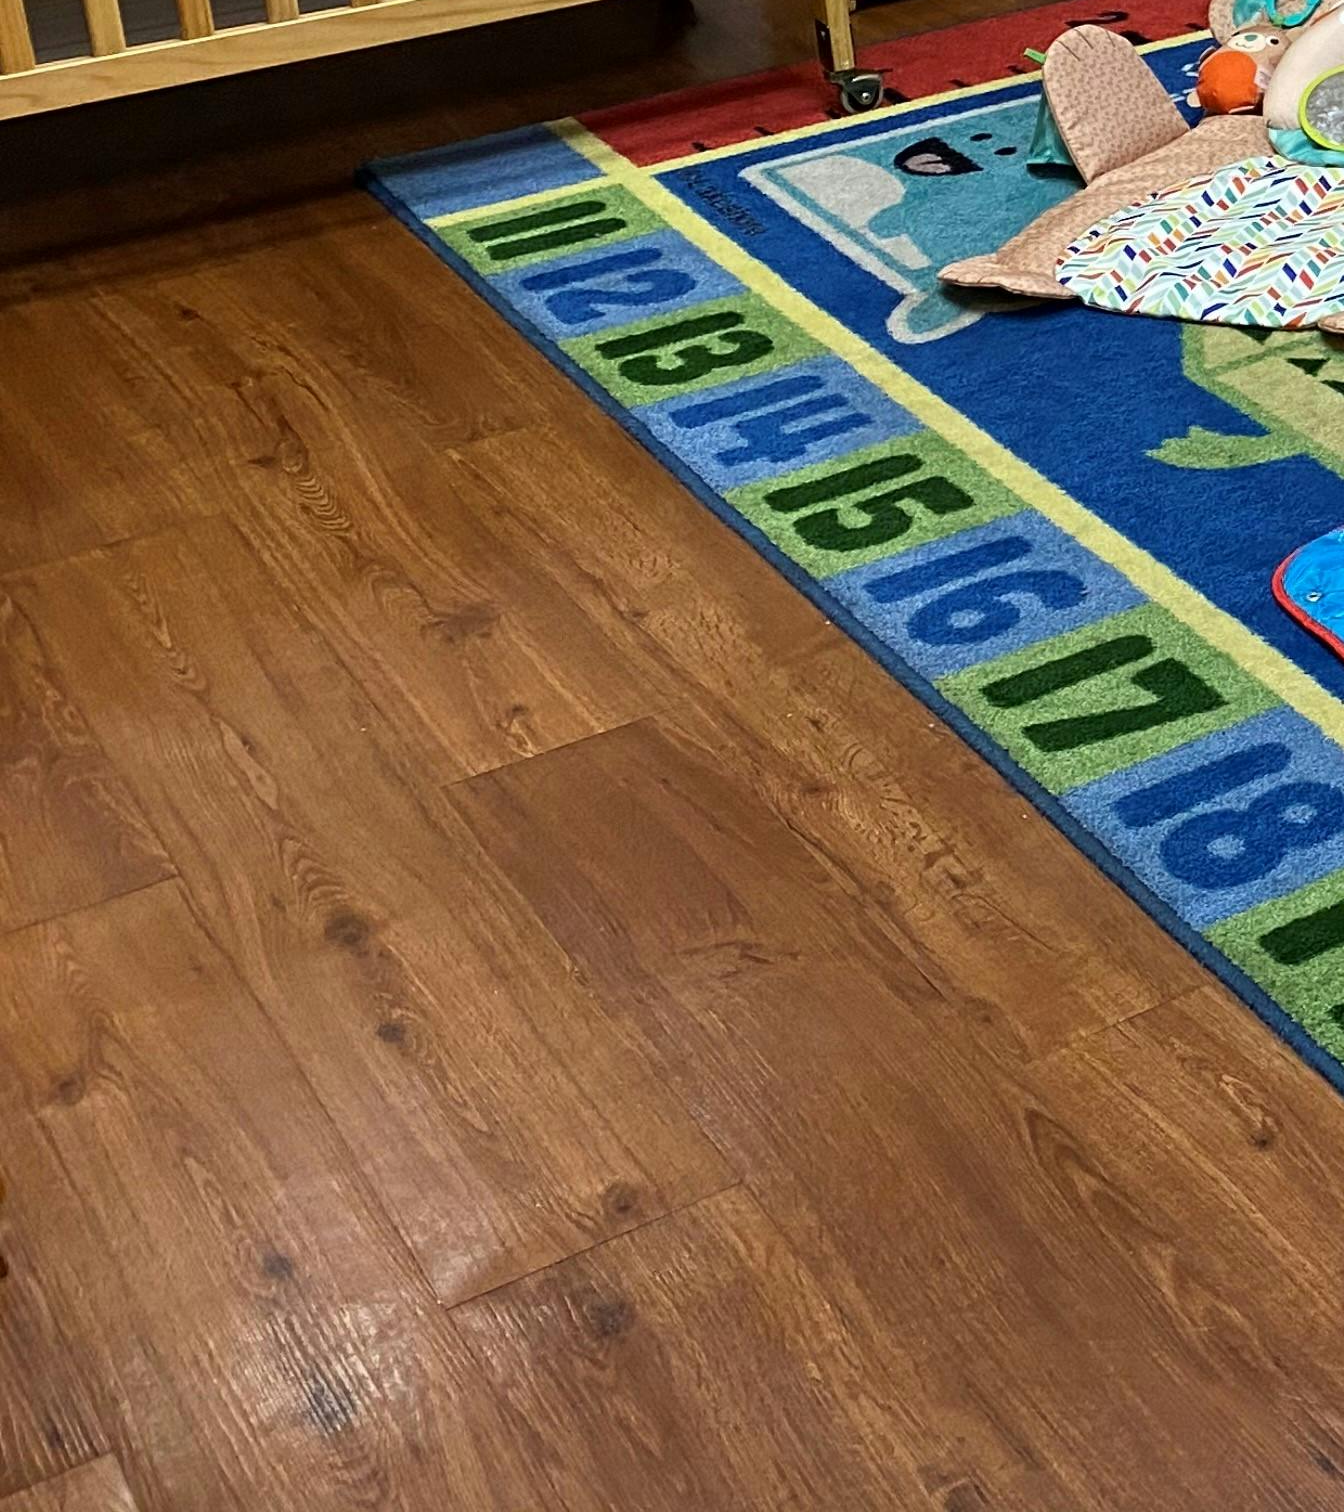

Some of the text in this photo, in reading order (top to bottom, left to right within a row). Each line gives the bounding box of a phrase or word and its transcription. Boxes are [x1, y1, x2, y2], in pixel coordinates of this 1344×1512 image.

[467, 199, 628, 261] 11
[520, 247, 697, 326] 12
[595, 311, 775, 387] 13
[667, 374, 876, 468] 14
[761, 453, 975, 552] 15
[860, 535, 1091, 648] 16
[982, 633, 1227, 753] 17
